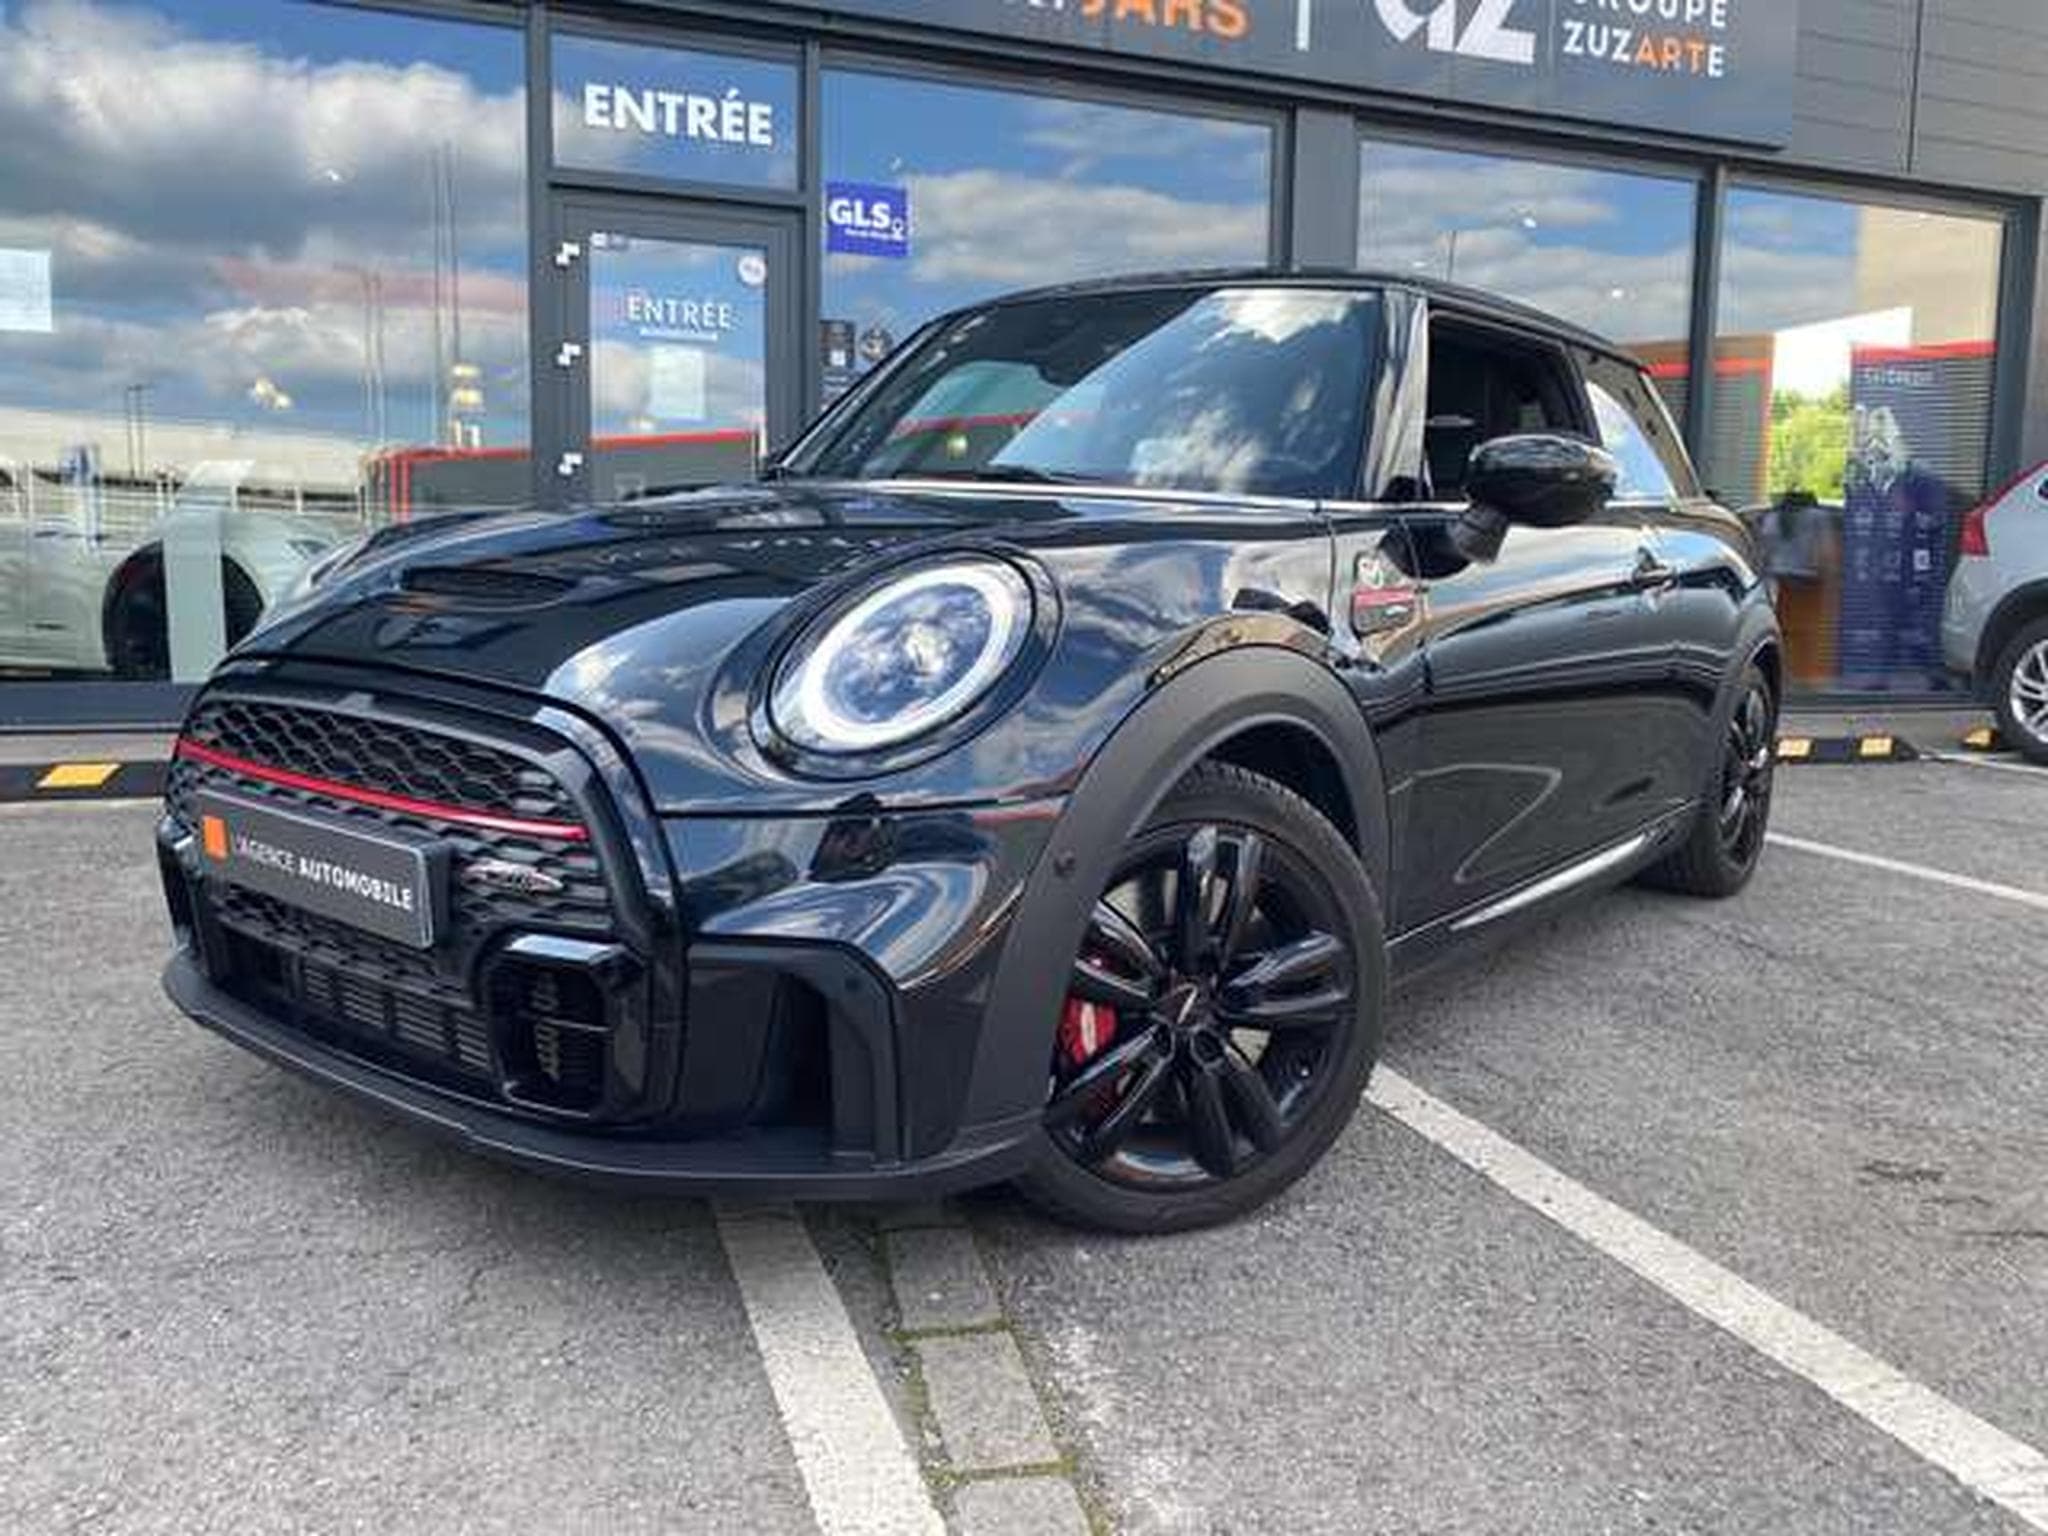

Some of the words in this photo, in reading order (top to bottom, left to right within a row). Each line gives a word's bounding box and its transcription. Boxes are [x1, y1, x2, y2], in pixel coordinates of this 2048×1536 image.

[1562, 19, 1725, 78] ZUZARTE
[584, 82, 773, 147] ENTRÉE
[829, 197, 891, 229] GLS
[299, 856, 413, 911] AUTOMOBILE
